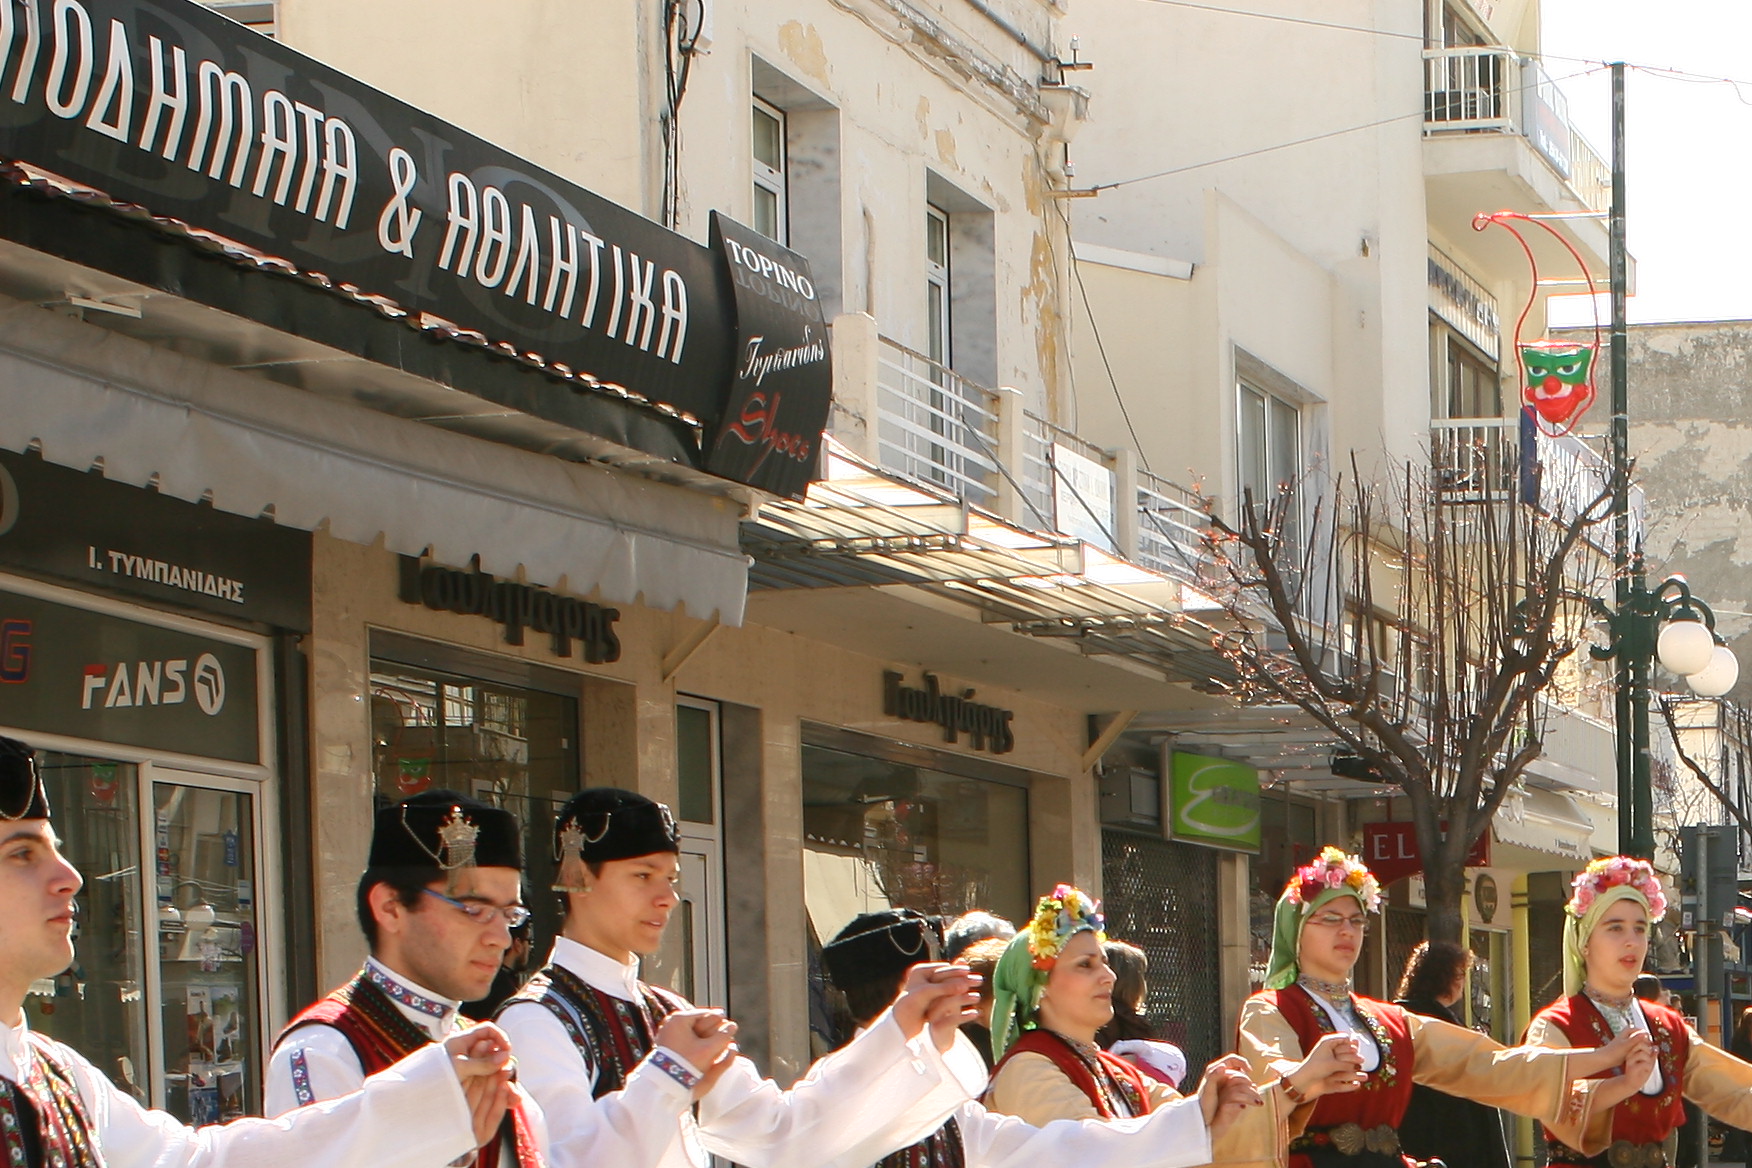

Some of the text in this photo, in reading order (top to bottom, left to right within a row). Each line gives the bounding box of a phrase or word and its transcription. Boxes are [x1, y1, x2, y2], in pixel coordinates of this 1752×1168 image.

[378, 146, 423, 259] &
[438, 171, 688, 364] ΑΘΛΗΤΙΚΑ
[726, 236, 815, 300] TOPINO
[716, 391, 811, 483] Shoes
[108, 550, 245, 604] ΤΥΜΠΑΝΙΔΗΣ
[82, 659, 187, 709] FANS
